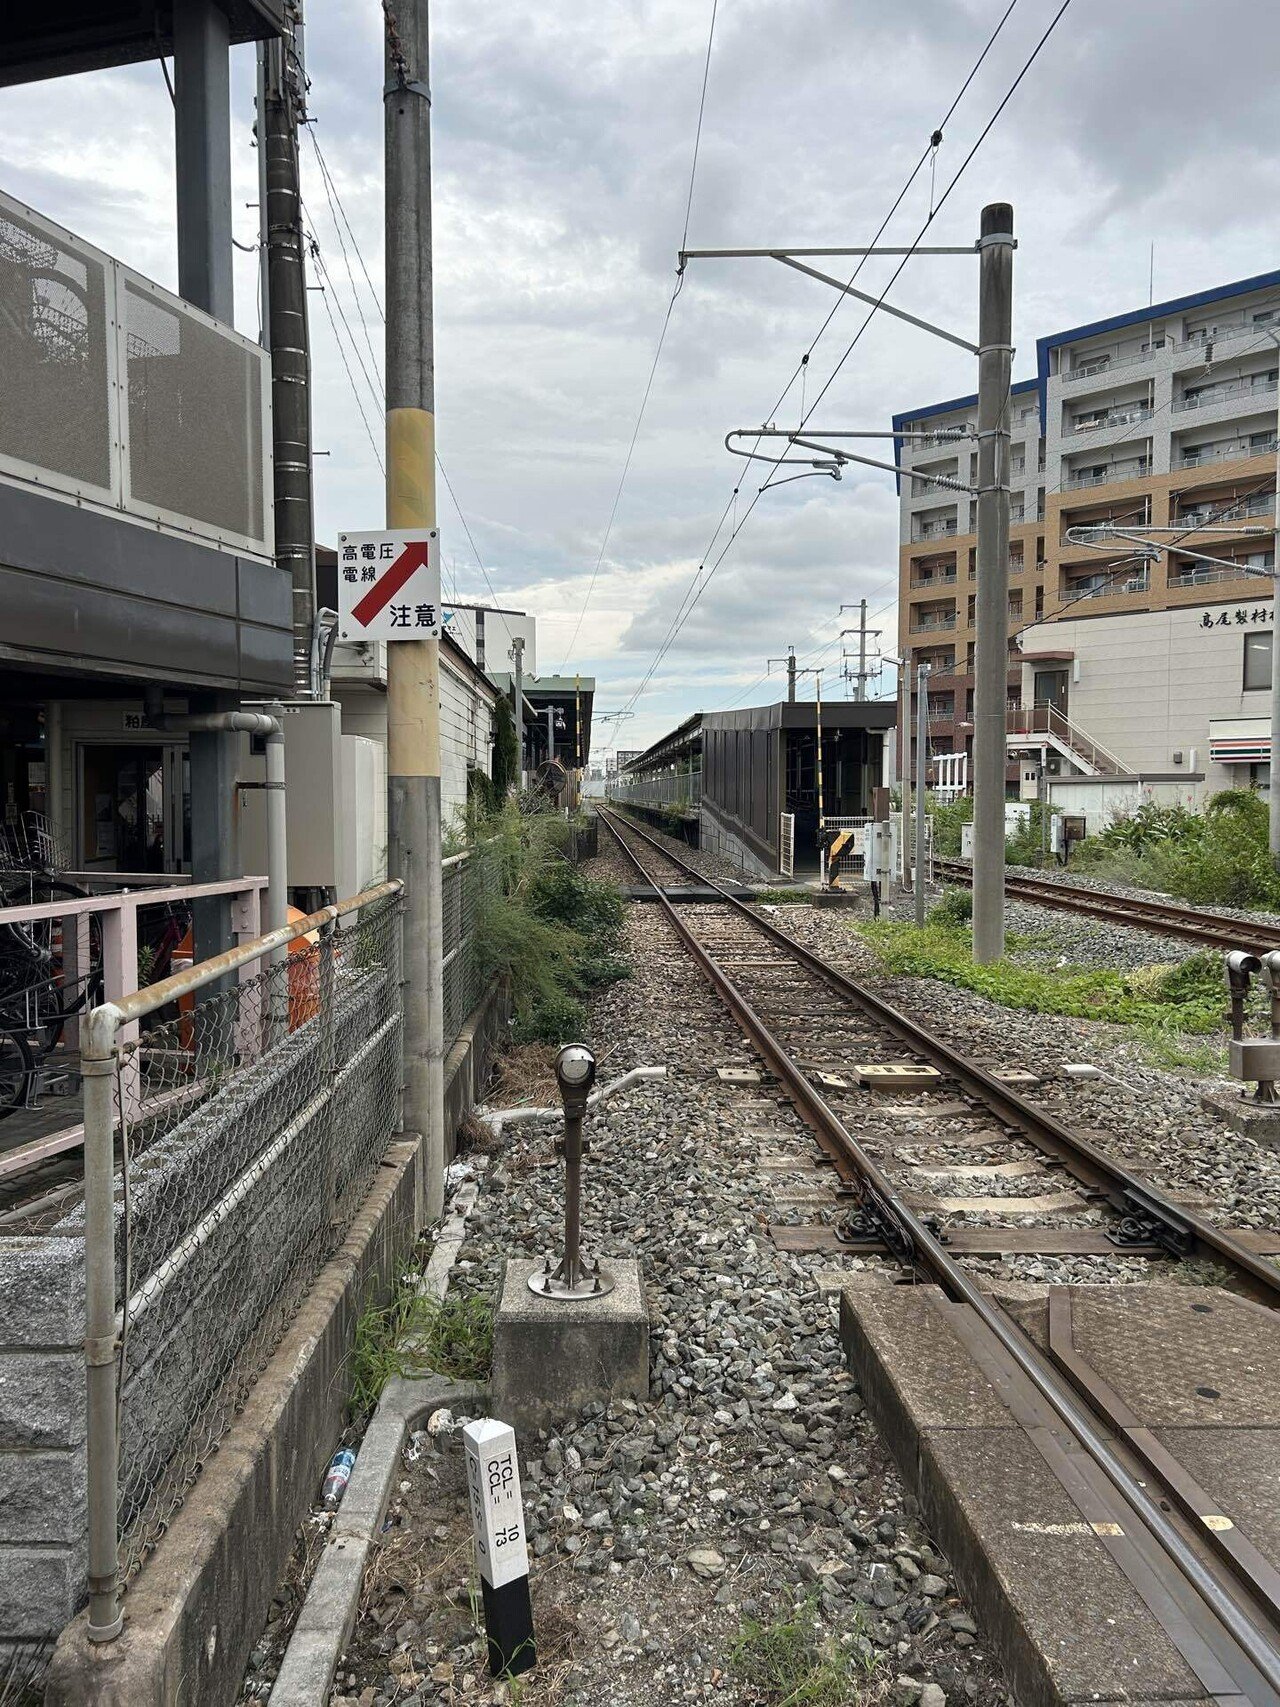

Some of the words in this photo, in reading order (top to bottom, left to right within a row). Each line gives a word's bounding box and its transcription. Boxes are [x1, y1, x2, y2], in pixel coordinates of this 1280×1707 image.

[343, 543, 394, 560] 高電圧
[343, 566, 376, 582] 電線
[389, 603, 437, 628] 注意
[495, 1528, 507, 1547] 73
[508, 1524, 520, 1542] 10
